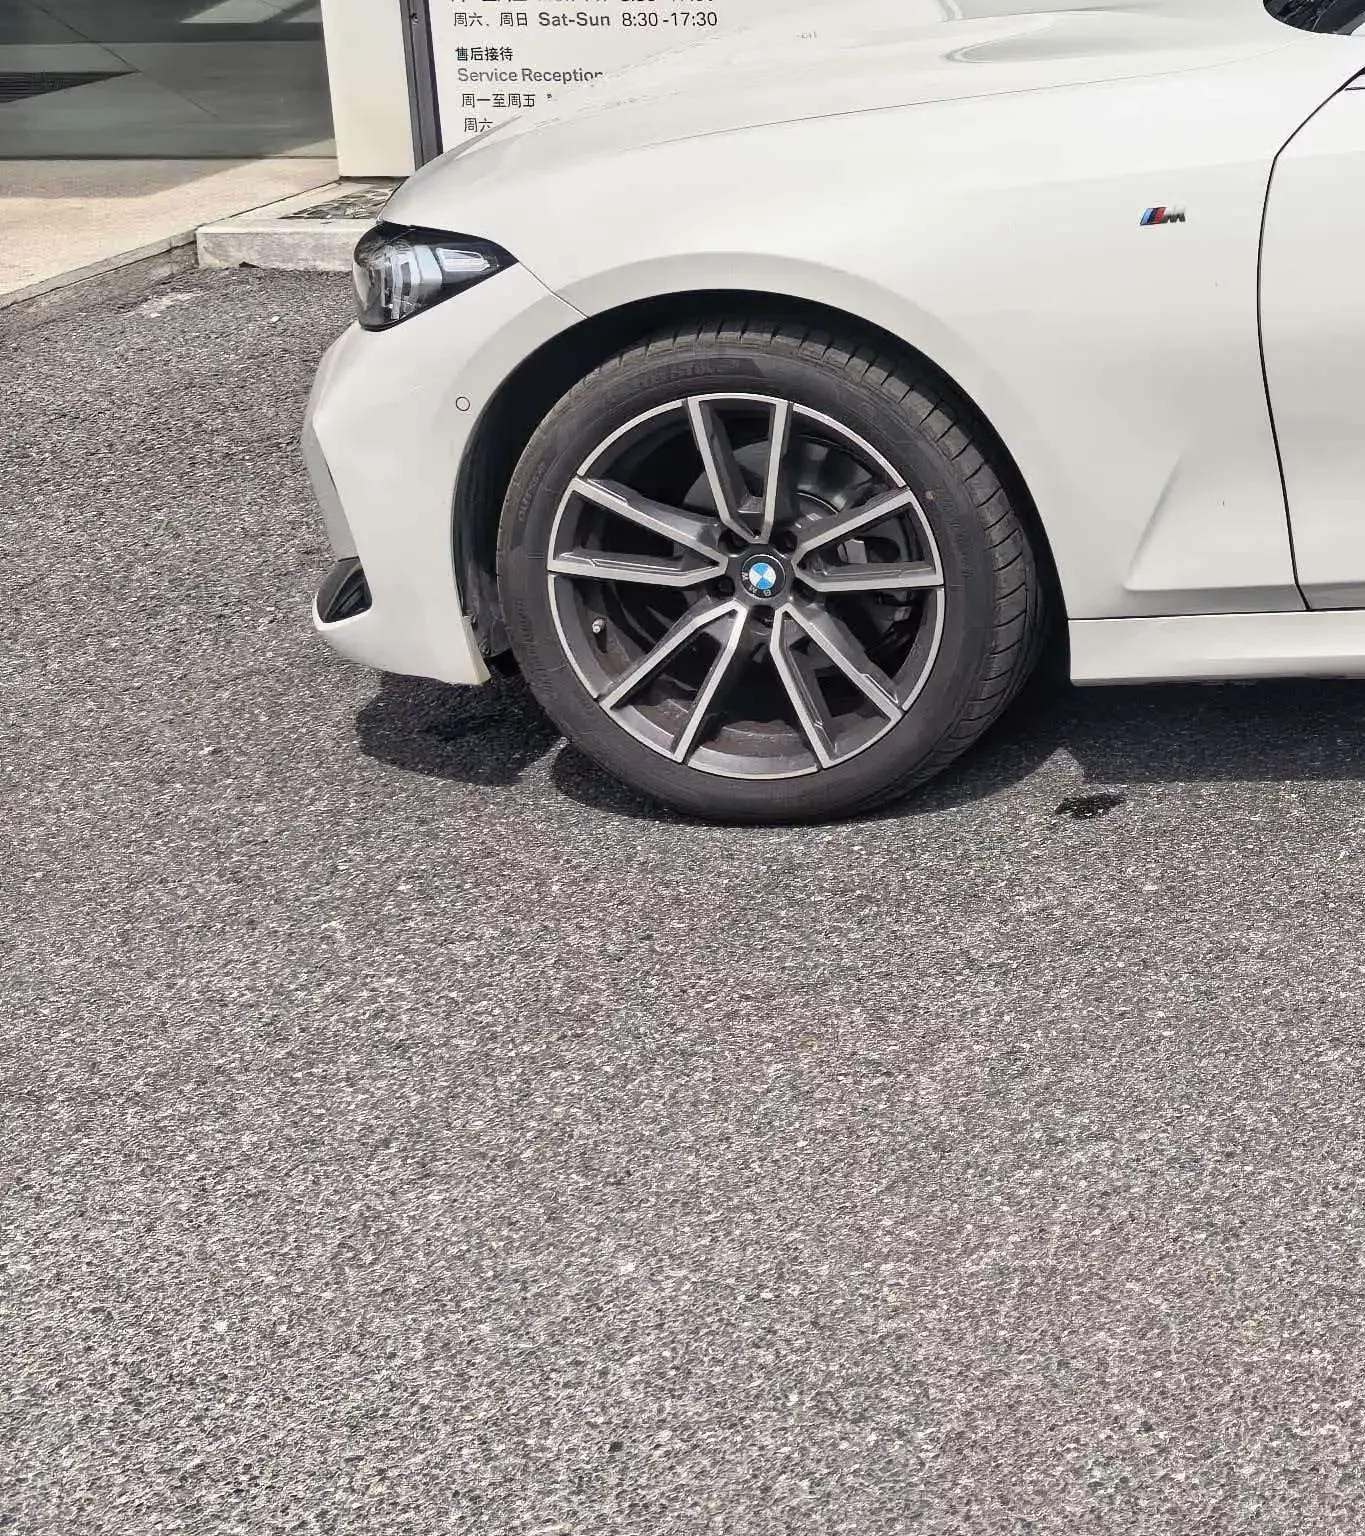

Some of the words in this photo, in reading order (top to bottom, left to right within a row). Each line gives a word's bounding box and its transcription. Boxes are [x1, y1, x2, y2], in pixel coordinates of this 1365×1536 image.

[454, 11, 527, 27] 周六、周日
[538, 12, 610, 27] Sat-Sun
[619, 10, 658, 27] 8:30
[455, 46, 513, 63] 售后接待
[457, 68, 518, 84] Service
[462, 92, 536, 108] 周一至周五
